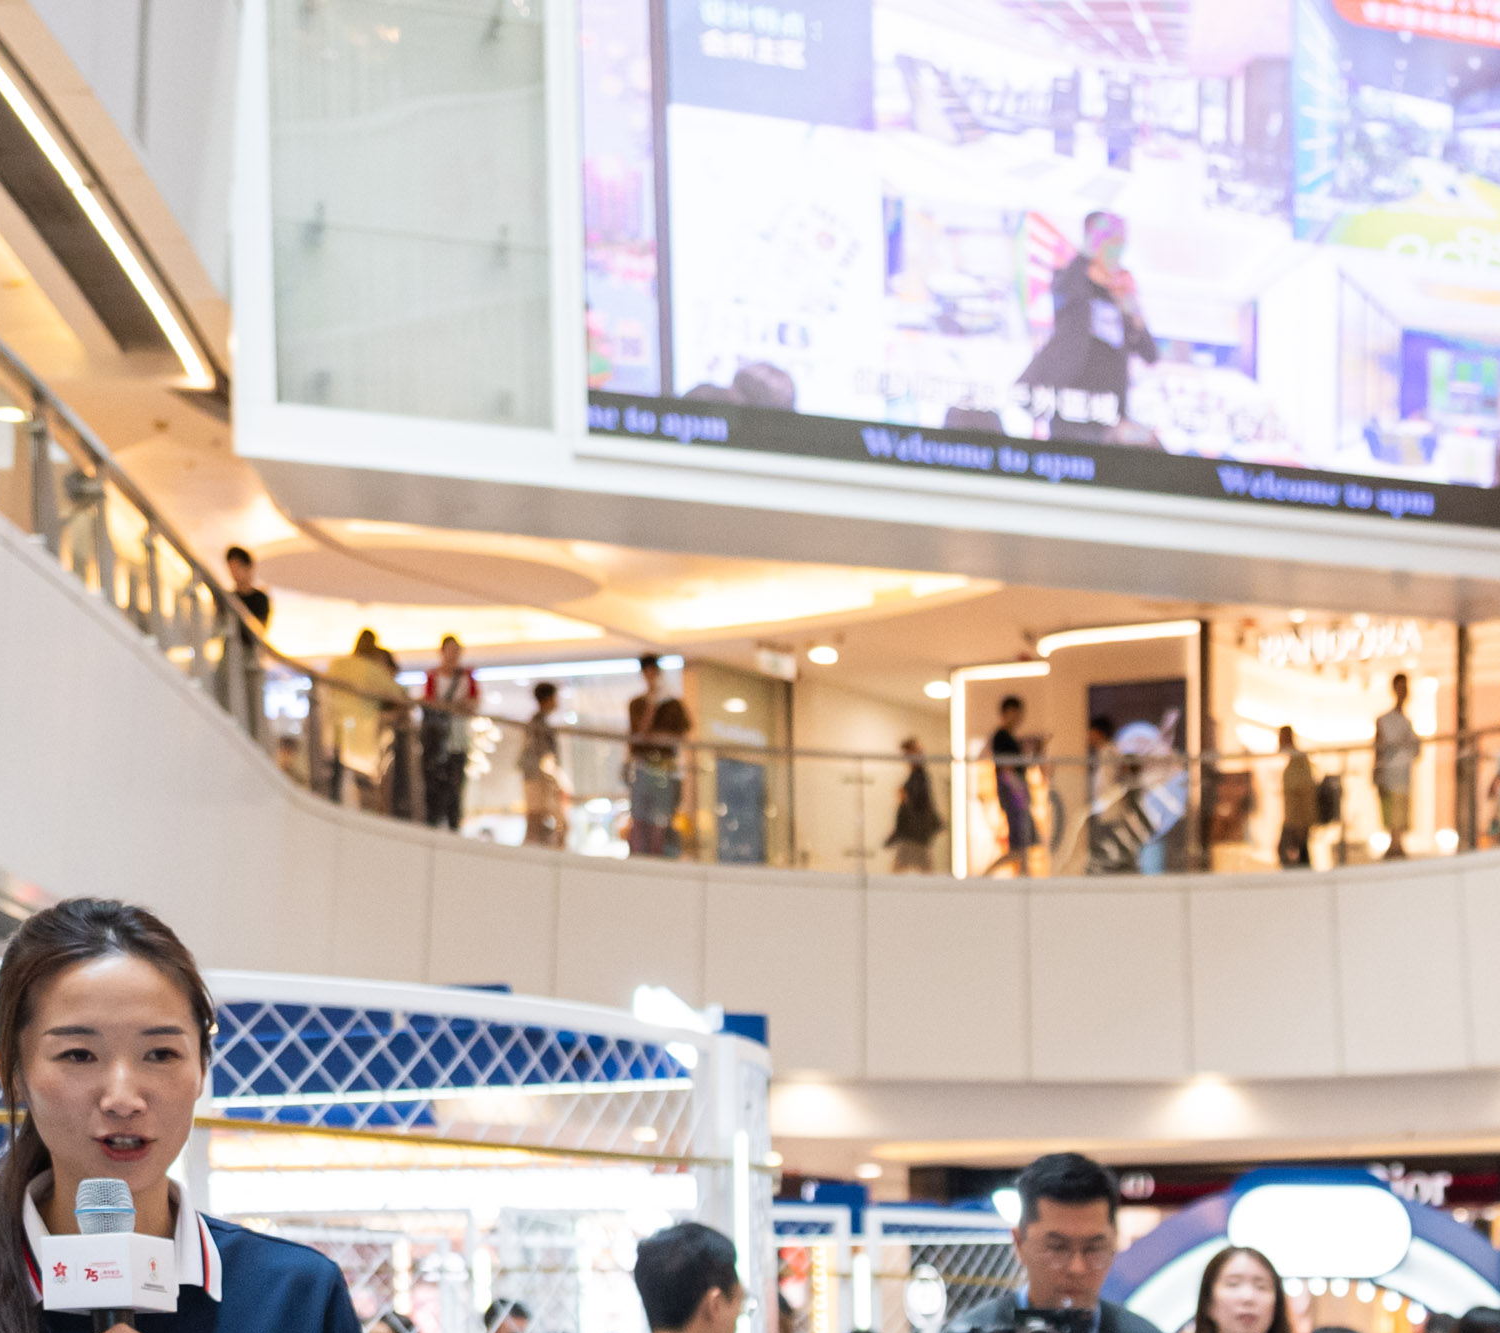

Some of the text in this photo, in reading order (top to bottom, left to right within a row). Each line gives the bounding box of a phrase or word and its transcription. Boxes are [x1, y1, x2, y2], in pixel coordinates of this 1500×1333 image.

[861, 426, 995, 471] Welcome
[1032, 451, 1095, 483] apm
[1216, 465, 1342, 506] Welcome
[1375, 488, 1435, 519] apm
